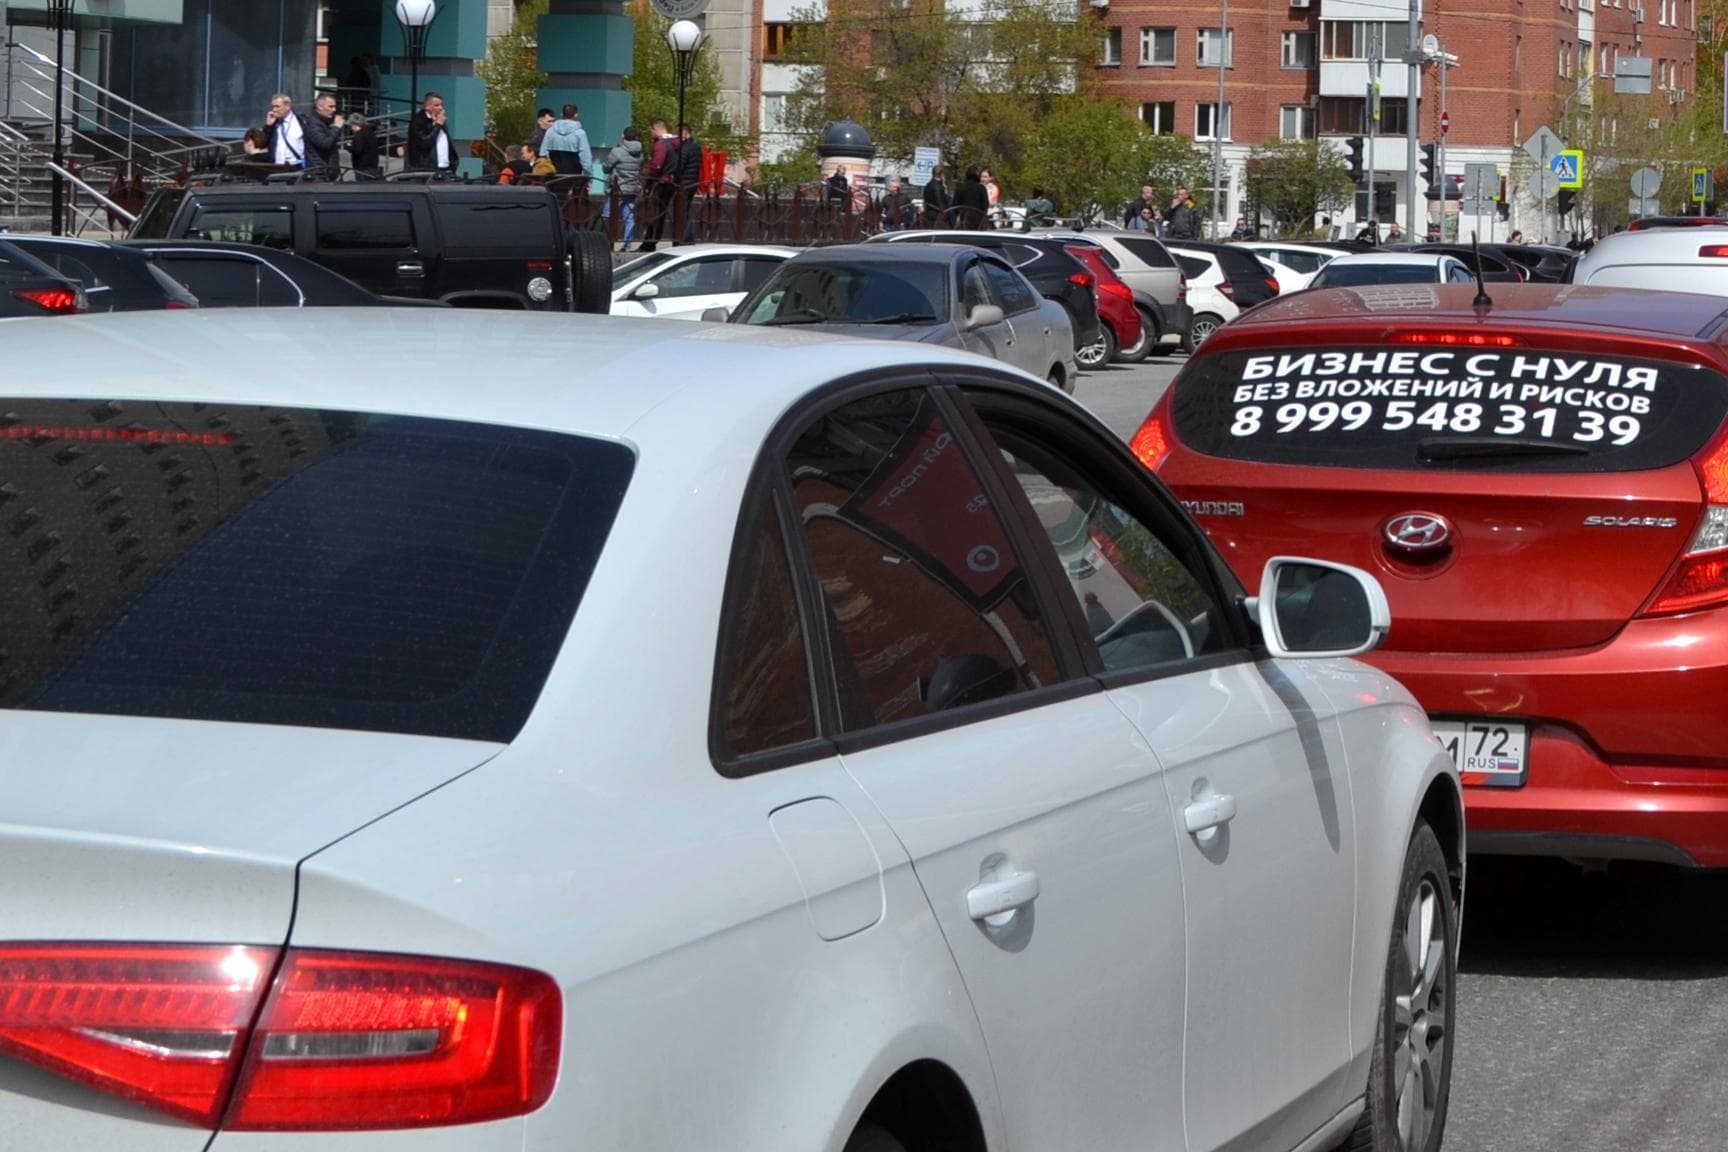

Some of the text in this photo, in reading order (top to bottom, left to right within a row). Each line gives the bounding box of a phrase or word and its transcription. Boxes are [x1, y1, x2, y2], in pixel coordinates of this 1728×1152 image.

[1242, 352, 1659, 392] БИЗНЕС С НУЛЯ
[1233, 376, 1651, 415] БЕЗ ВЛОЖЕНИЙ И РИСКОВ
[1230, 401, 1641, 446] 8 999 548 31 39
[1583, 515, 1678, 528] SOLARIS
[1472, 725, 1509, 757] 72
[1467, 757, 1497, 769] RUS
